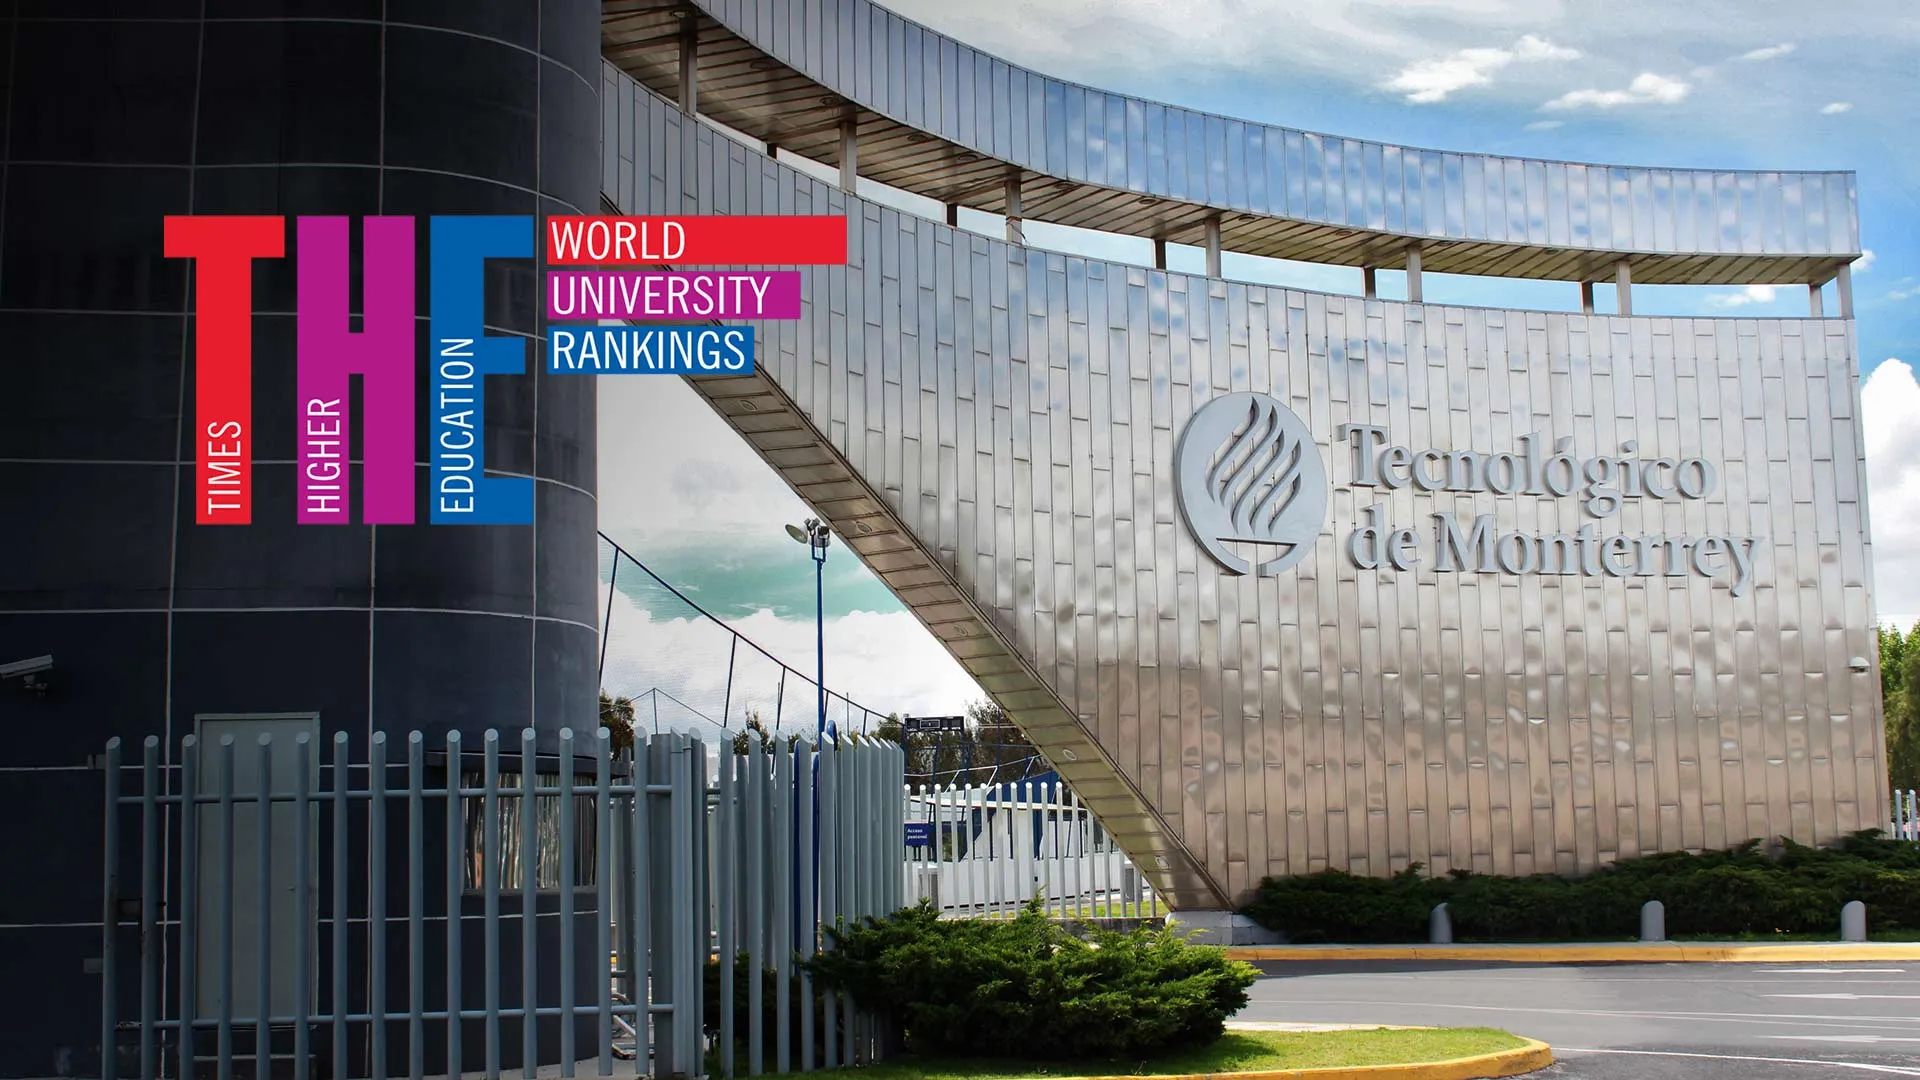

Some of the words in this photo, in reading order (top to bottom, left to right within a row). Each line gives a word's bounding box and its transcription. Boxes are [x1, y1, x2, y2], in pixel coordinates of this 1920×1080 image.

[1338, 423, 1716, 518] Tecnológico
[1350, 502, 1422, 571] de
[1432, 511, 1763, 597] Monterrey
